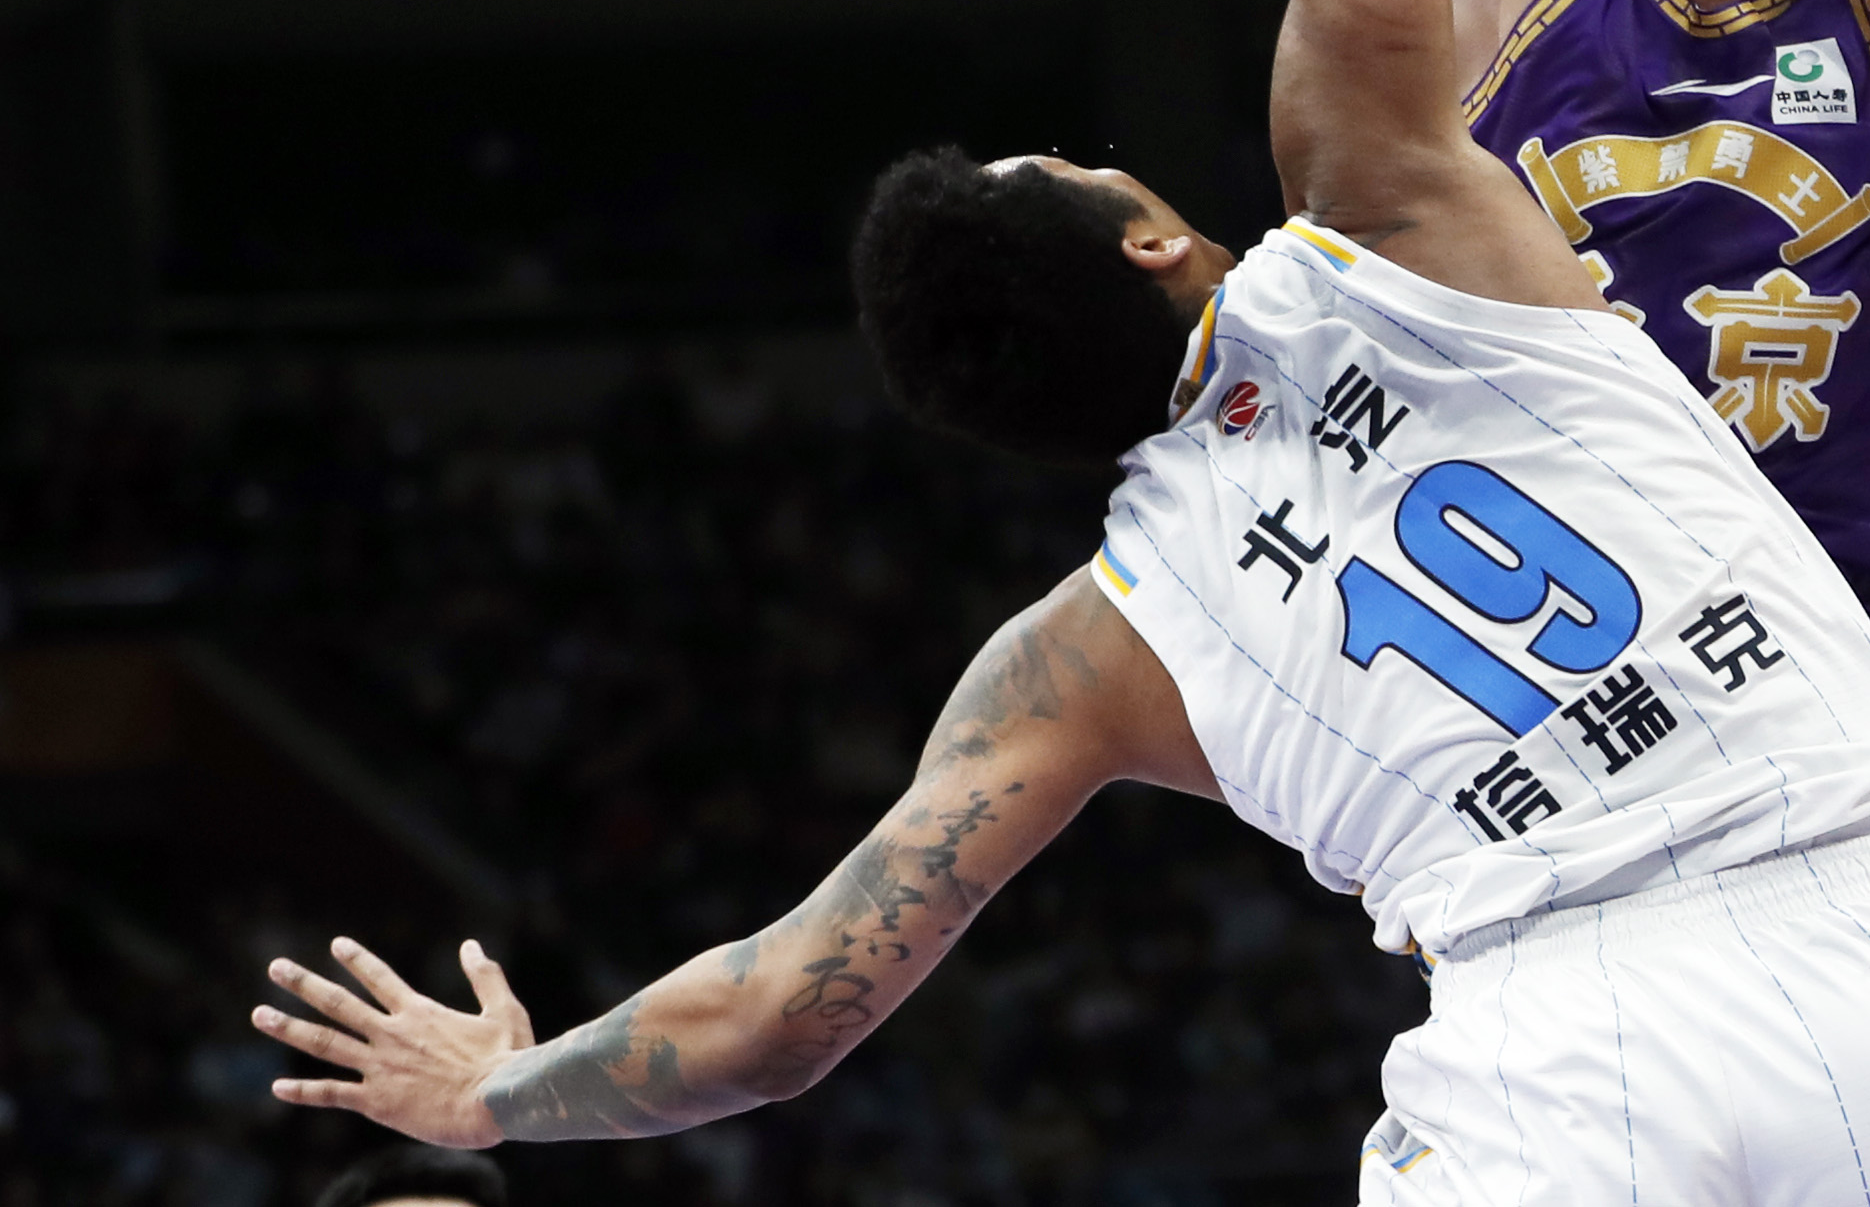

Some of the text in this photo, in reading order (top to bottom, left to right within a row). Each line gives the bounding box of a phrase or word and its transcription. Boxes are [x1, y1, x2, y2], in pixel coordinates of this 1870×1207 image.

[1776, 88, 1847, 104] 中国人寿
[1780, 104, 1848, 114] CHINA LIFE
[1237, 363, 1410, 603] 北汽
[1336, 459, 1643, 738] 19
